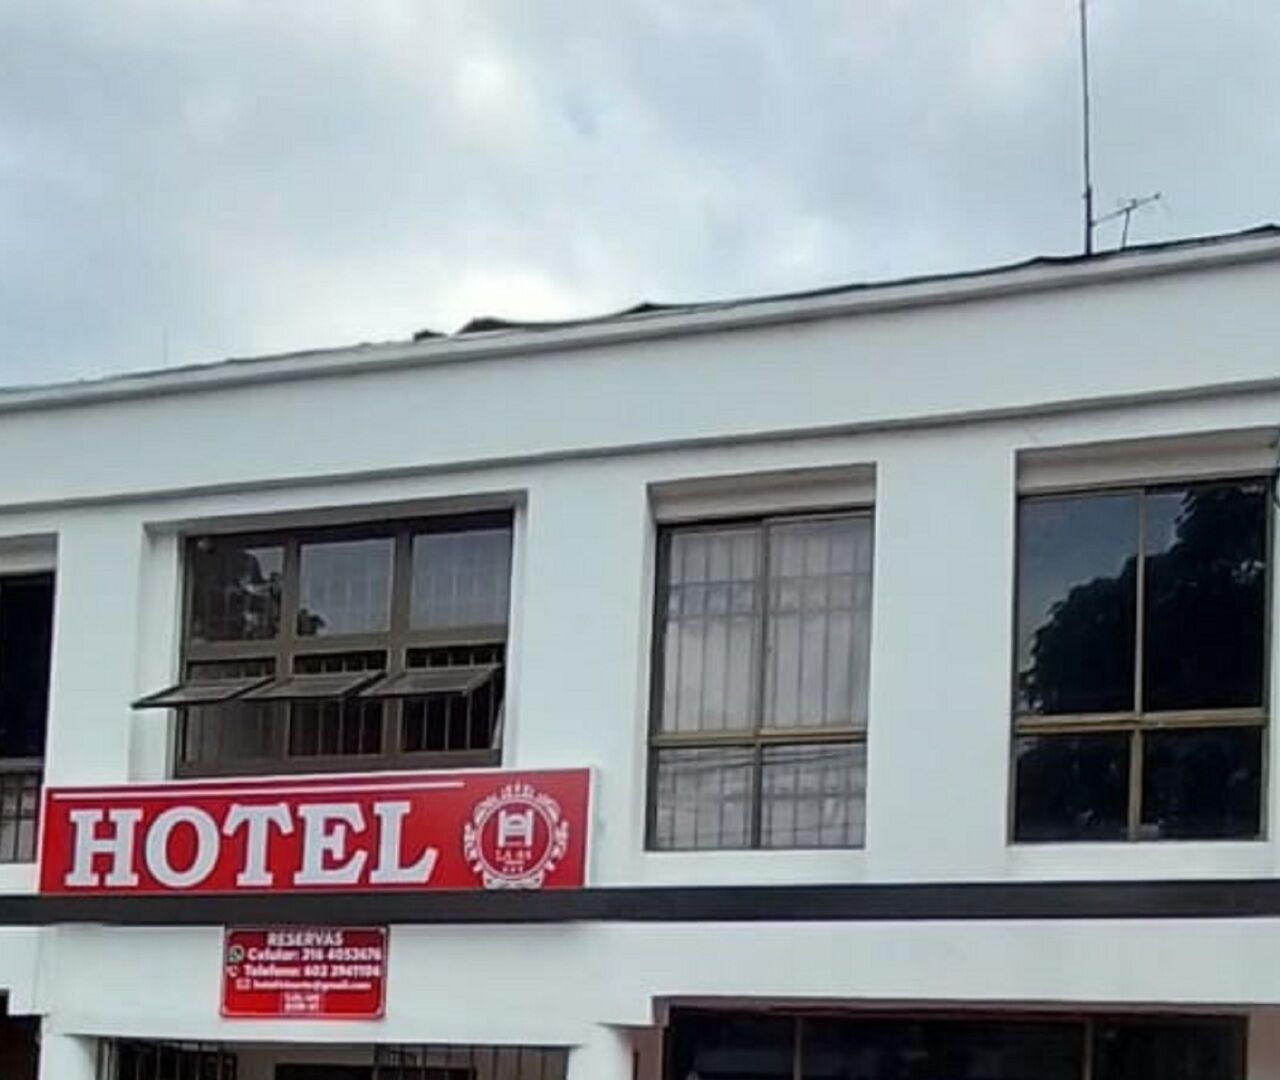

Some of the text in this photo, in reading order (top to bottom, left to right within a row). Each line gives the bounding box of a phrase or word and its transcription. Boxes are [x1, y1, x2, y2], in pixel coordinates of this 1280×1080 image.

[64, 801, 439, 888] HOTEL
[267, 931, 344, 947] RESERVAS
[247, 947, 300, 962] Celular:
